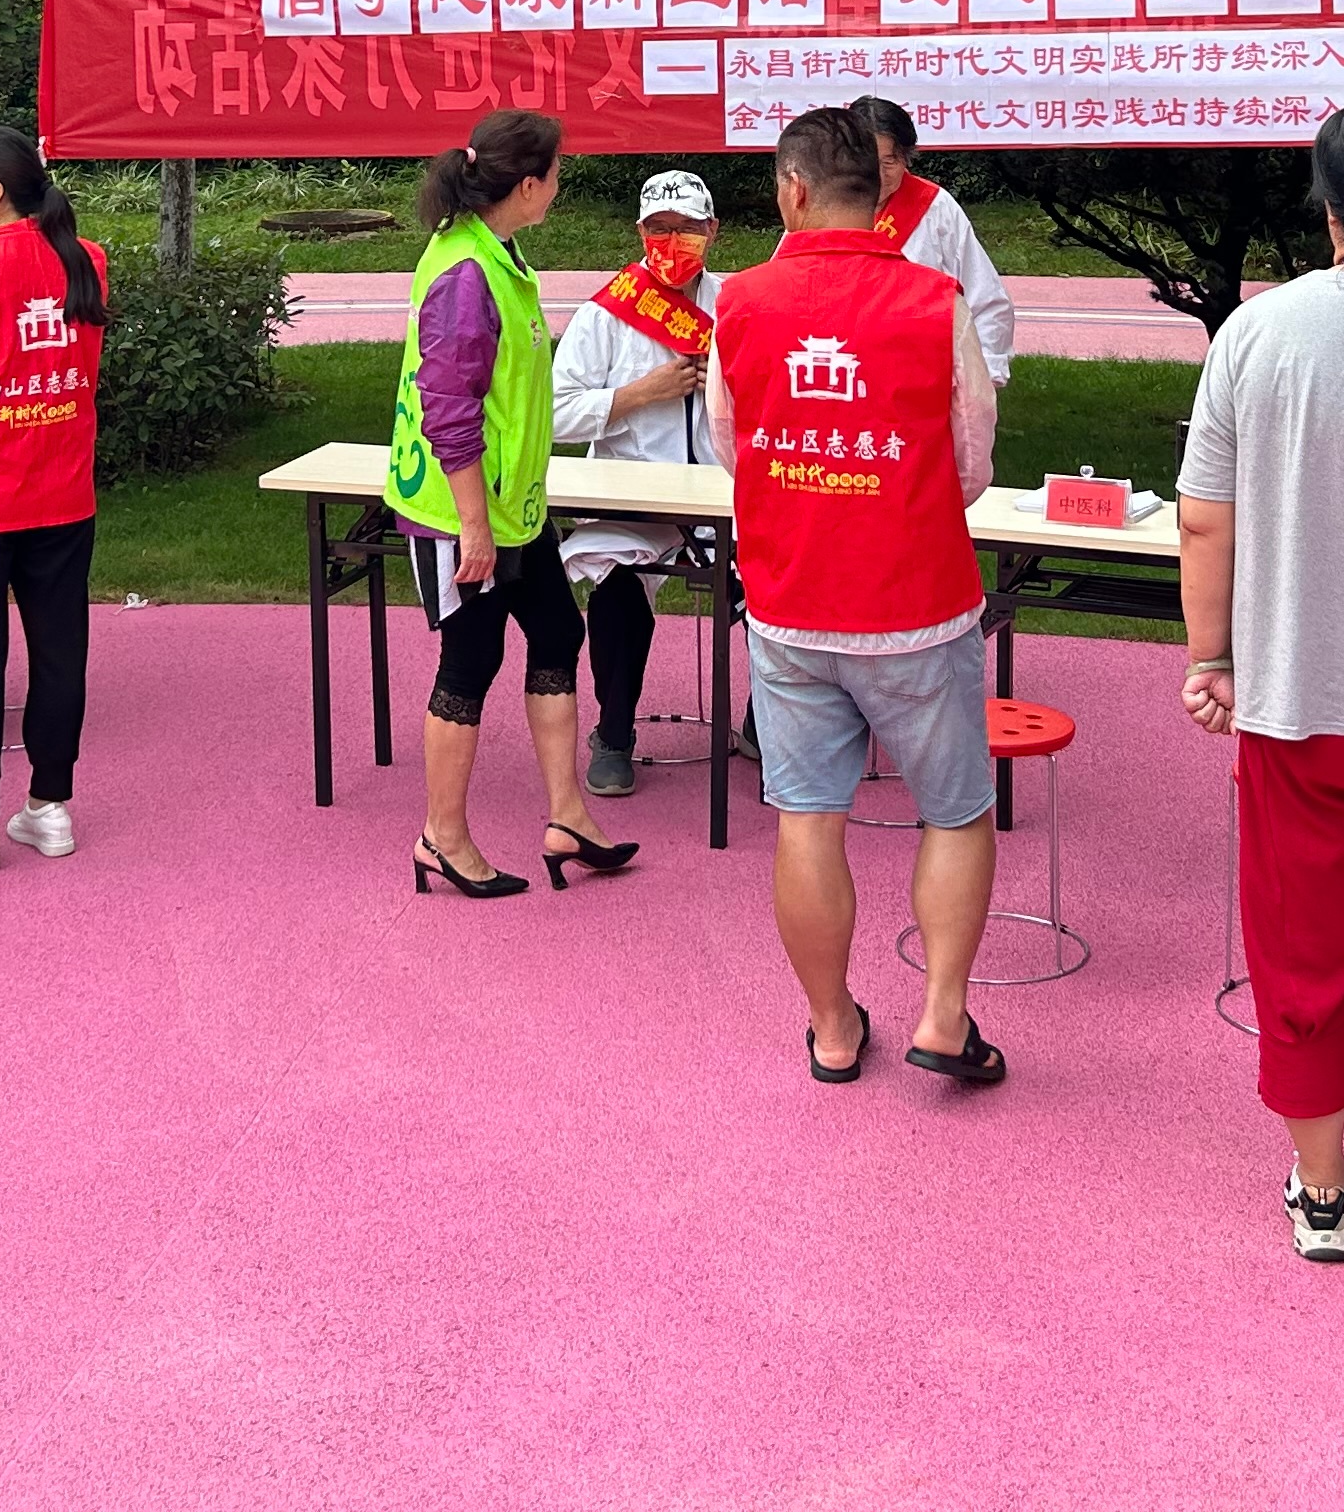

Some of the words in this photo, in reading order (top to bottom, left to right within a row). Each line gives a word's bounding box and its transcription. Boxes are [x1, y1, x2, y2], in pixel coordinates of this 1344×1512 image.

[751, 427, 907, 462] 西山区志愿者
[1059, 496, 1113, 517] 中医科
